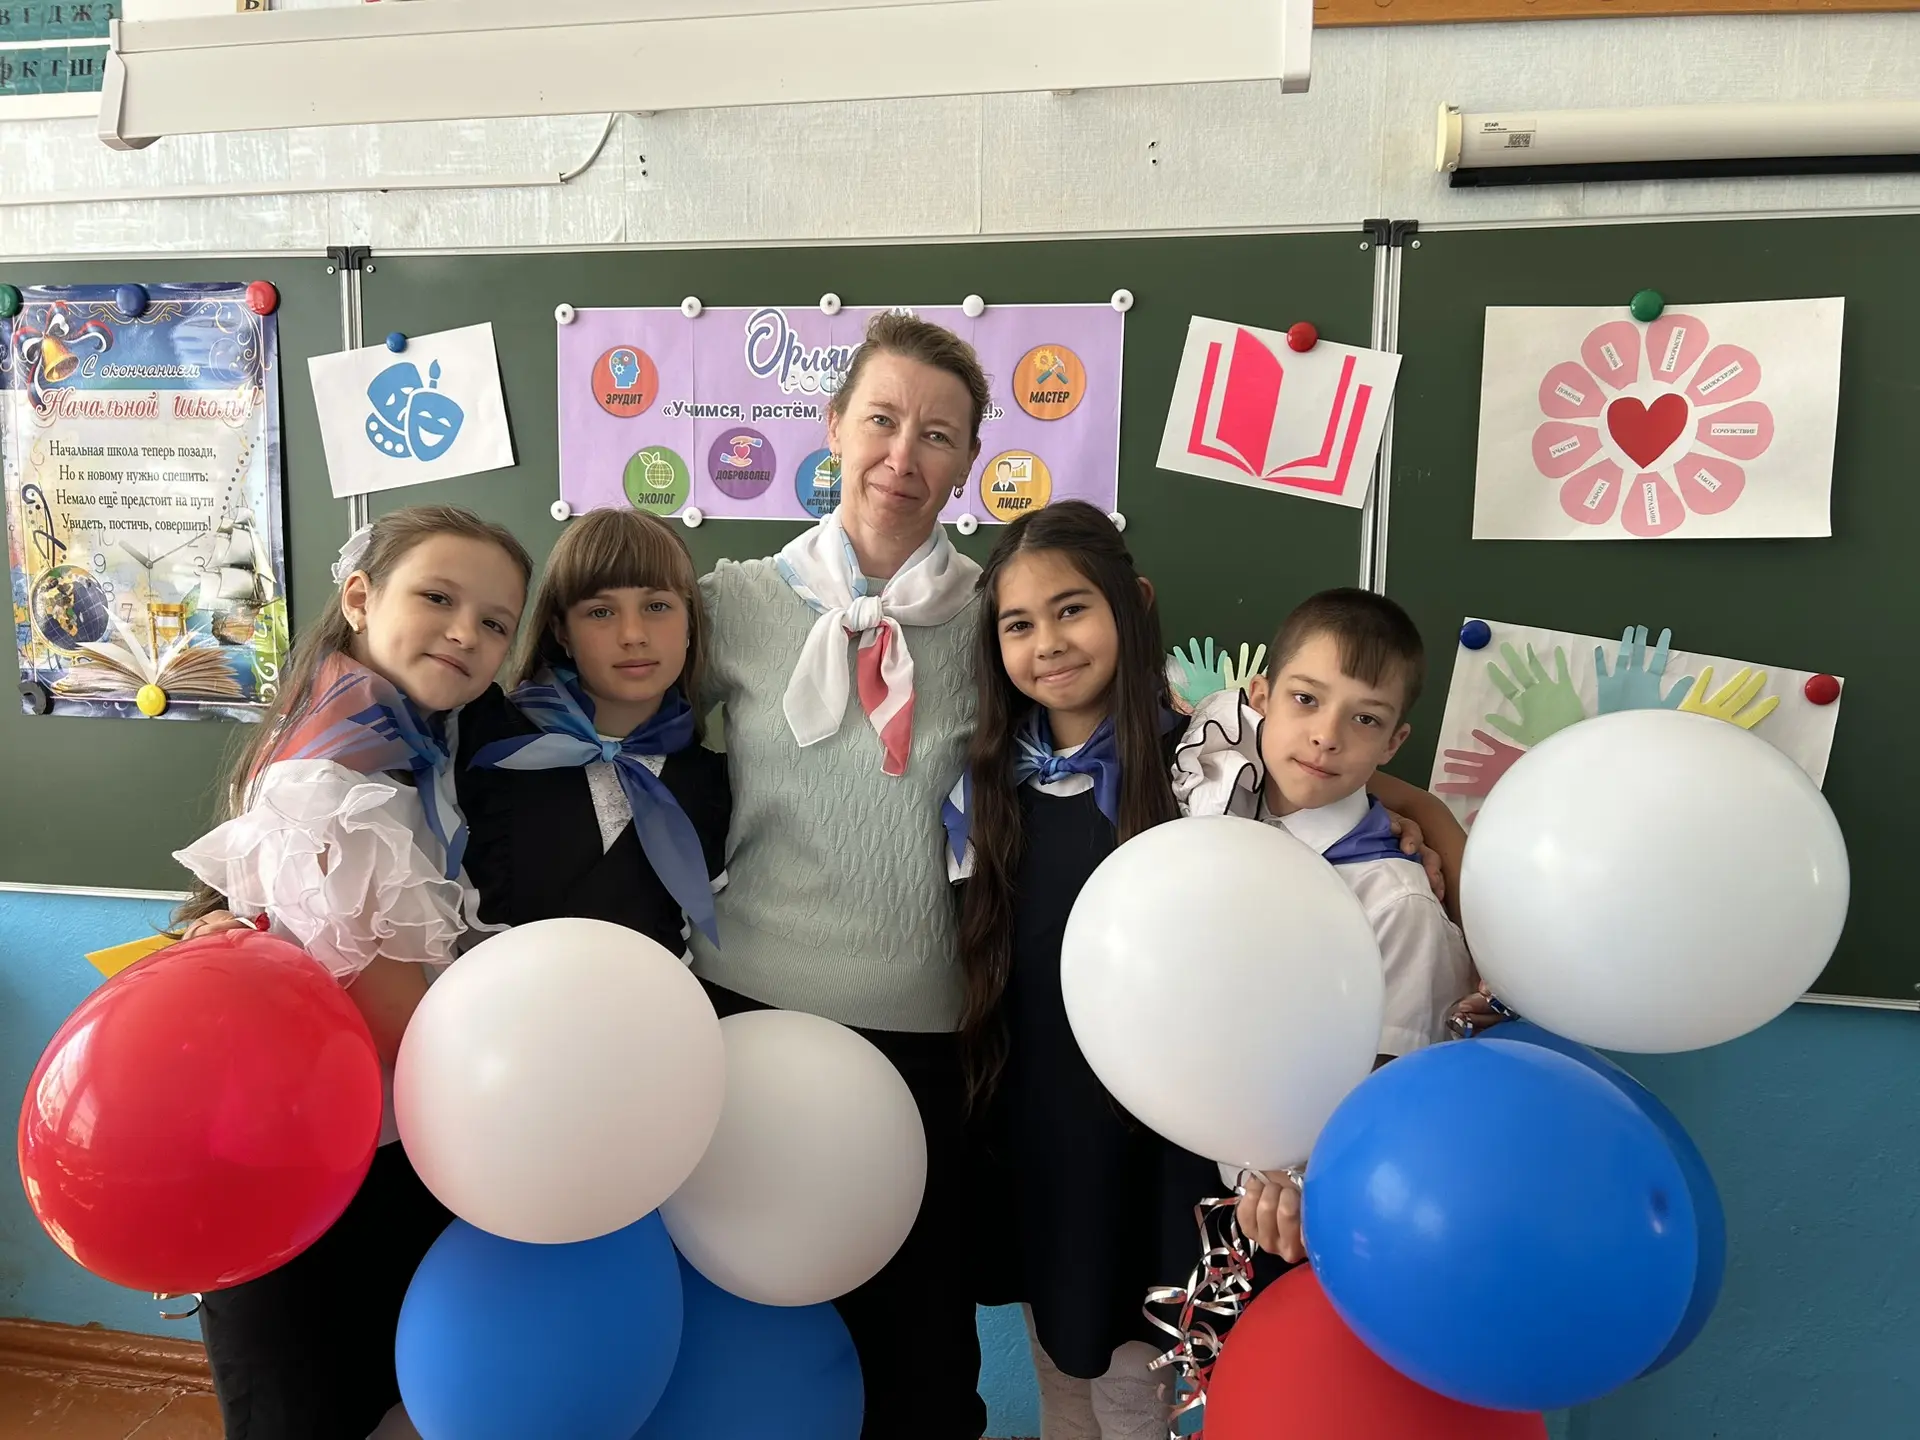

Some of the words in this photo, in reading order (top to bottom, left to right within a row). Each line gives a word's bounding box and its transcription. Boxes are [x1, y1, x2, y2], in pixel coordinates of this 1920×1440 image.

[747, 308, 862, 383] Орля
[82, 354, 97, 376] С
[101, 362, 200, 378] окончанием
[37, 388, 158, 418] Начальной
[606, 393, 643, 405] ЭРУДИТ
[1029, 391, 1070, 403] МАСТЕР
[663, 401, 745, 420] «Учимся,
[752, 401, 822, 421] растём,
[1712, 427, 1756, 435] СОЧУВСТВИЕ
[49, 440, 104, 457] Начальная
[107, 446, 139, 457] школа
[141, 446, 175, 460] теперь
[177, 446, 217, 459] позади,
[59, 464, 76, 481] Но
[78, 471, 85, 480] к
[87, 471, 123, 484] новому
[126, 471, 160, 484] нужно
[162, 472, 209, 482] спешить:
[715, 470, 771, 481] ДОБРОВОЛЕЦ
[56, 488, 96, 505] Немало
[99, 491, 118, 508] ещё
[121, 495, 172, 509] предстоит
[175, 496, 188, 506] на
[190, 496, 214, 510] пути
[637, 492, 677, 505] ЭКОЛОГ
[997, 497, 1032, 510] ЛИДЕР
[61, 513, 106, 532] Увидеть,
[109, 519, 152, 532] постичь,
[155, 515, 212, 534] совершить!
